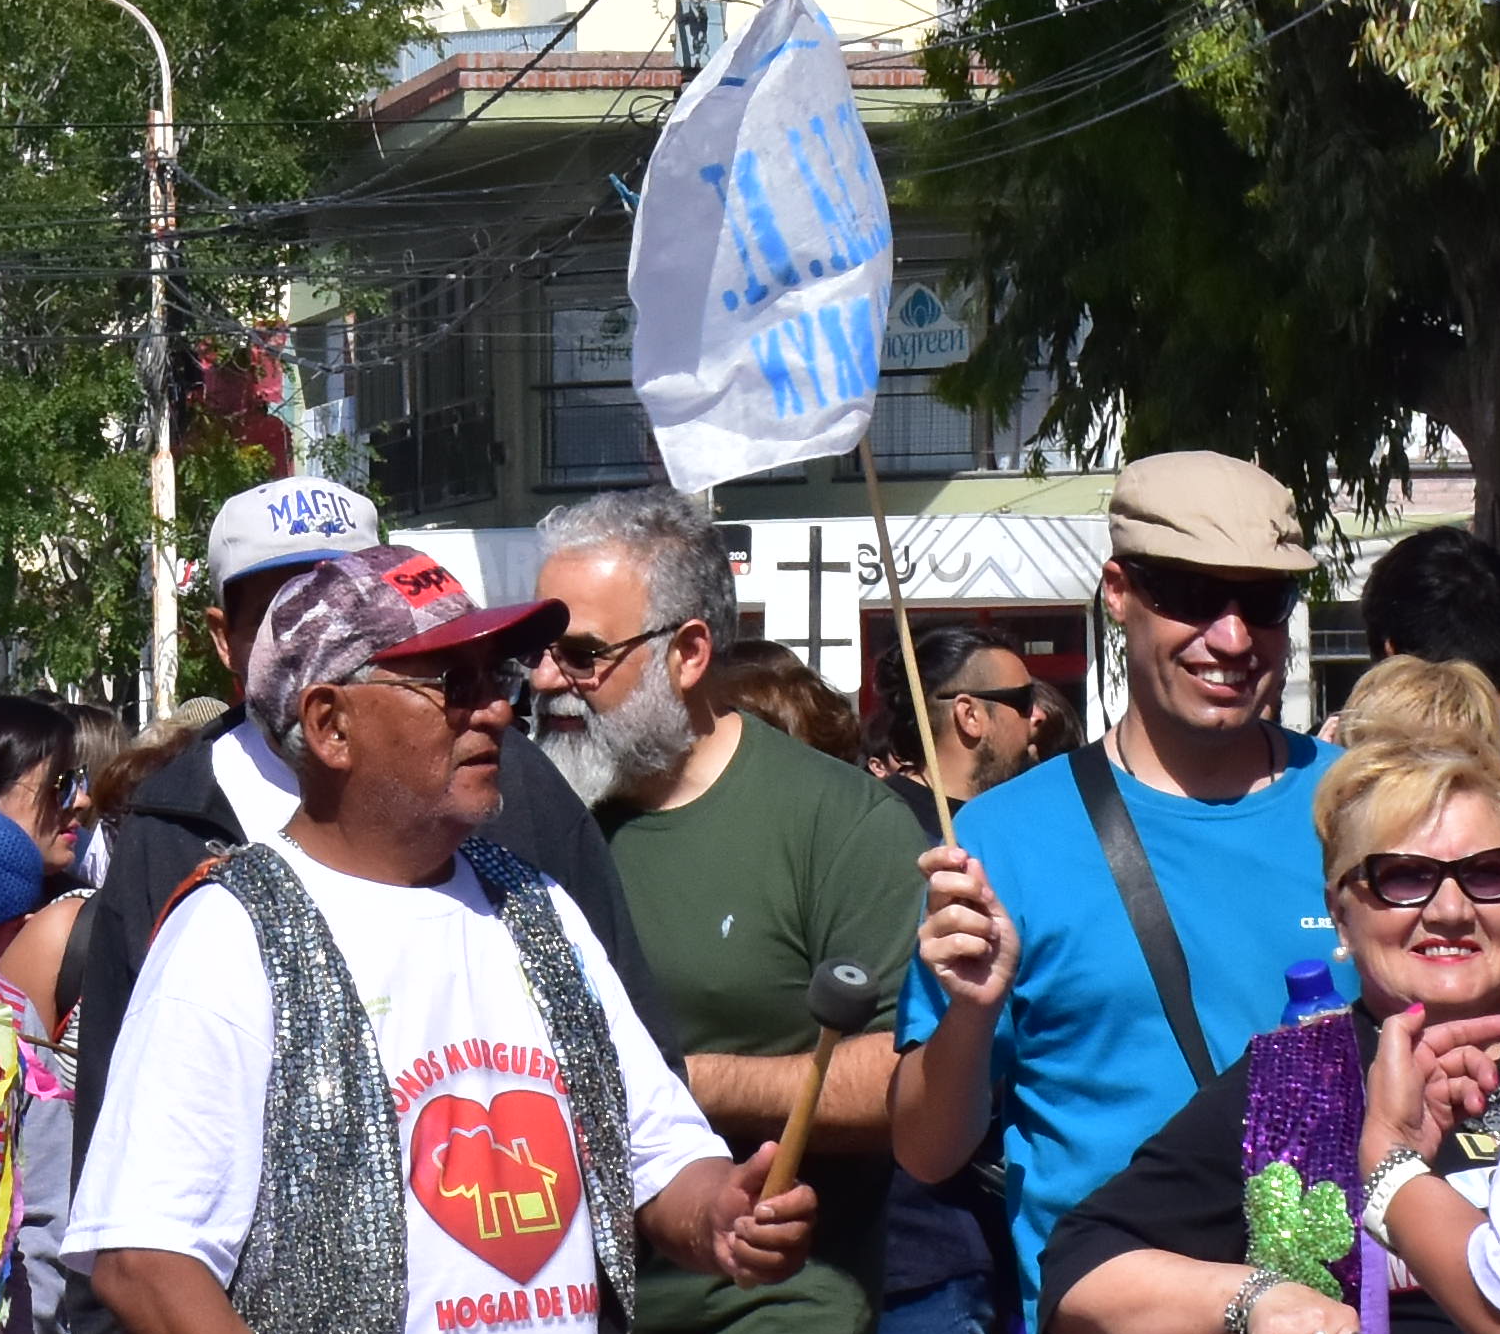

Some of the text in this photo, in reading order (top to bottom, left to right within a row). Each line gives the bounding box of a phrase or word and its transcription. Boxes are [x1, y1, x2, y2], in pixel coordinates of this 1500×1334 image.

[267, 489, 357, 532] MAGIC
[729, 551, 747, 561] 200
[392, 1038, 570, 1115] ONOS MURGUERO
[436, 1293, 532, 1331] HOGAR
[534, 1285, 565, 1321] DE
